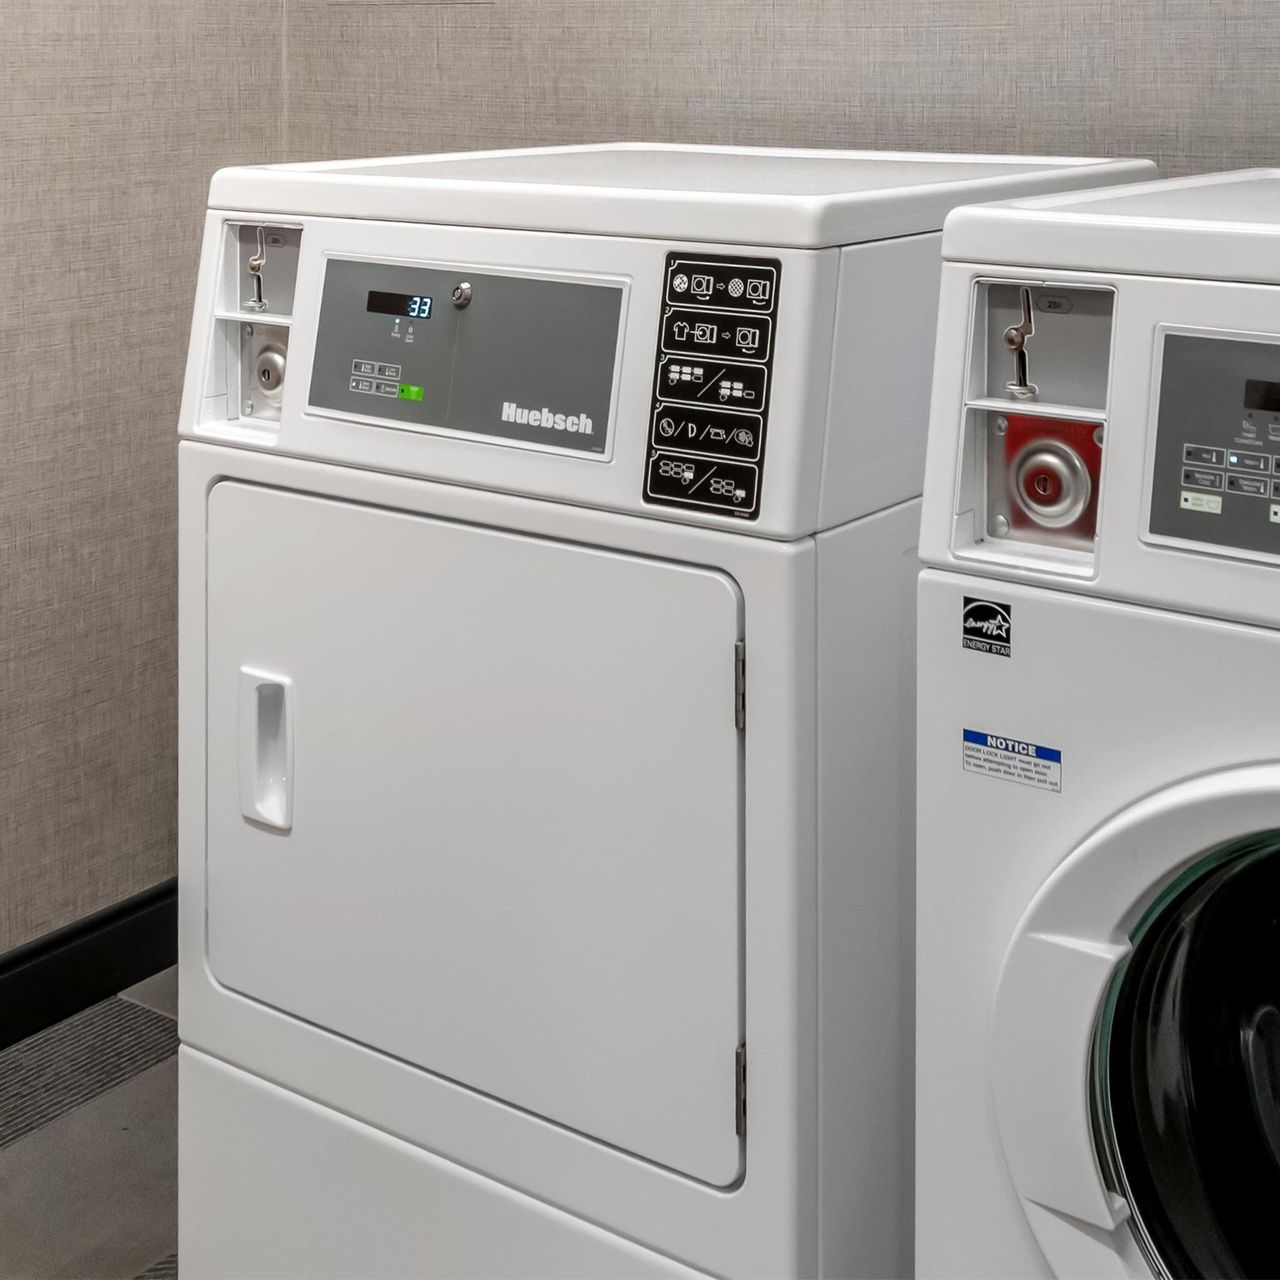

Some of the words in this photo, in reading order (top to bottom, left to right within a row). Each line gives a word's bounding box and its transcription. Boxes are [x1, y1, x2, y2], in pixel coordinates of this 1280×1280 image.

[409, 296, 431, 317] 33
[501, 401, 594, 435] Huebsch
[963, 638, 990, 652] ENERGY
[991, 644, 1010, 656] STAR
[986, 735, 1037, 757] NOTICE
